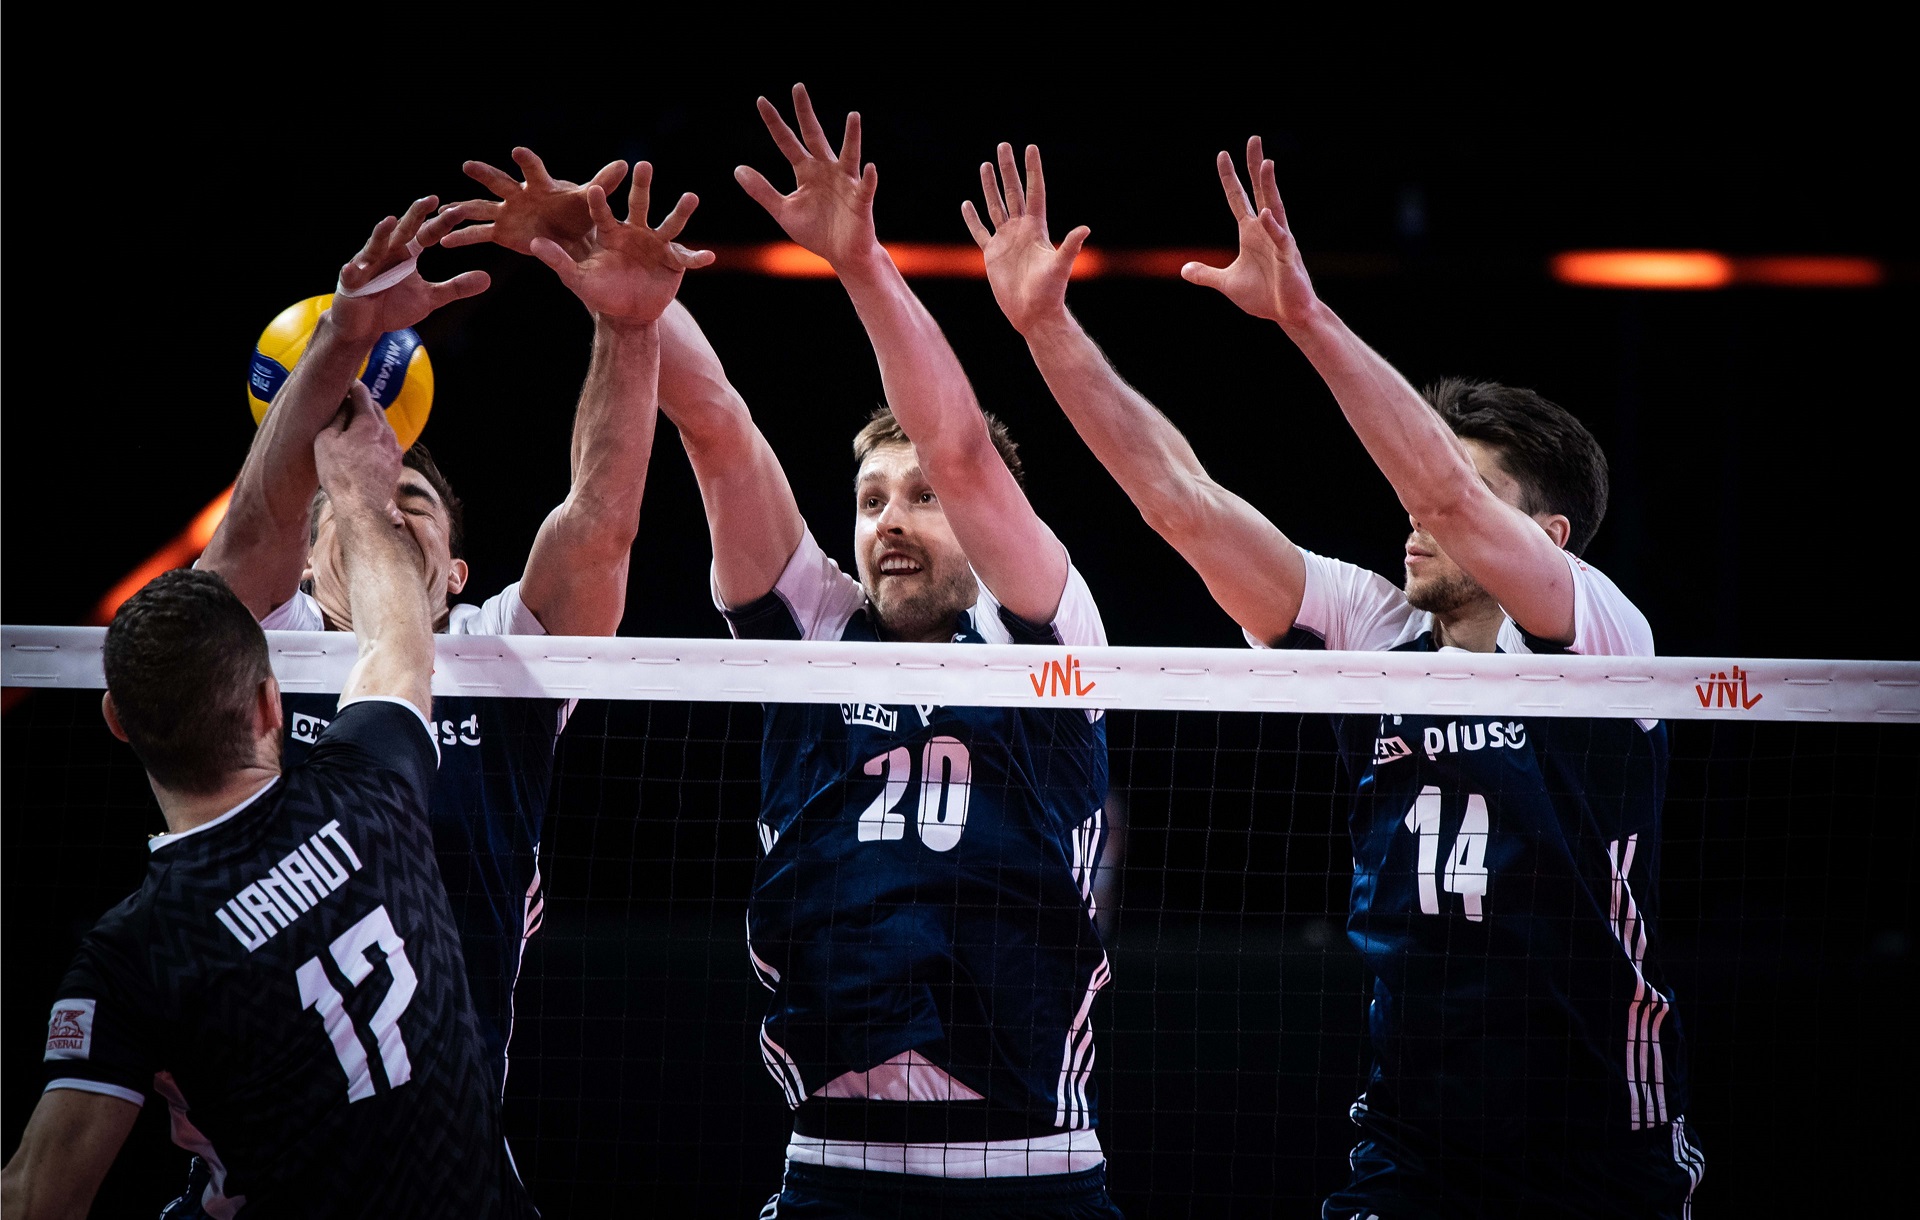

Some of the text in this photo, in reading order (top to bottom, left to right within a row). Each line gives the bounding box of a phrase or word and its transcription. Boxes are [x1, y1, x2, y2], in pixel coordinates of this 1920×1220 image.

[1030, 654, 1096, 698] VNL
[1695, 665, 1763, 710] VNL
[857, 735, 972, 852] 20
[1404, 784, 1489, 923] 14
[214, 818, 363, 953] URNAUT
[295, 904, 418, 1104] 17
